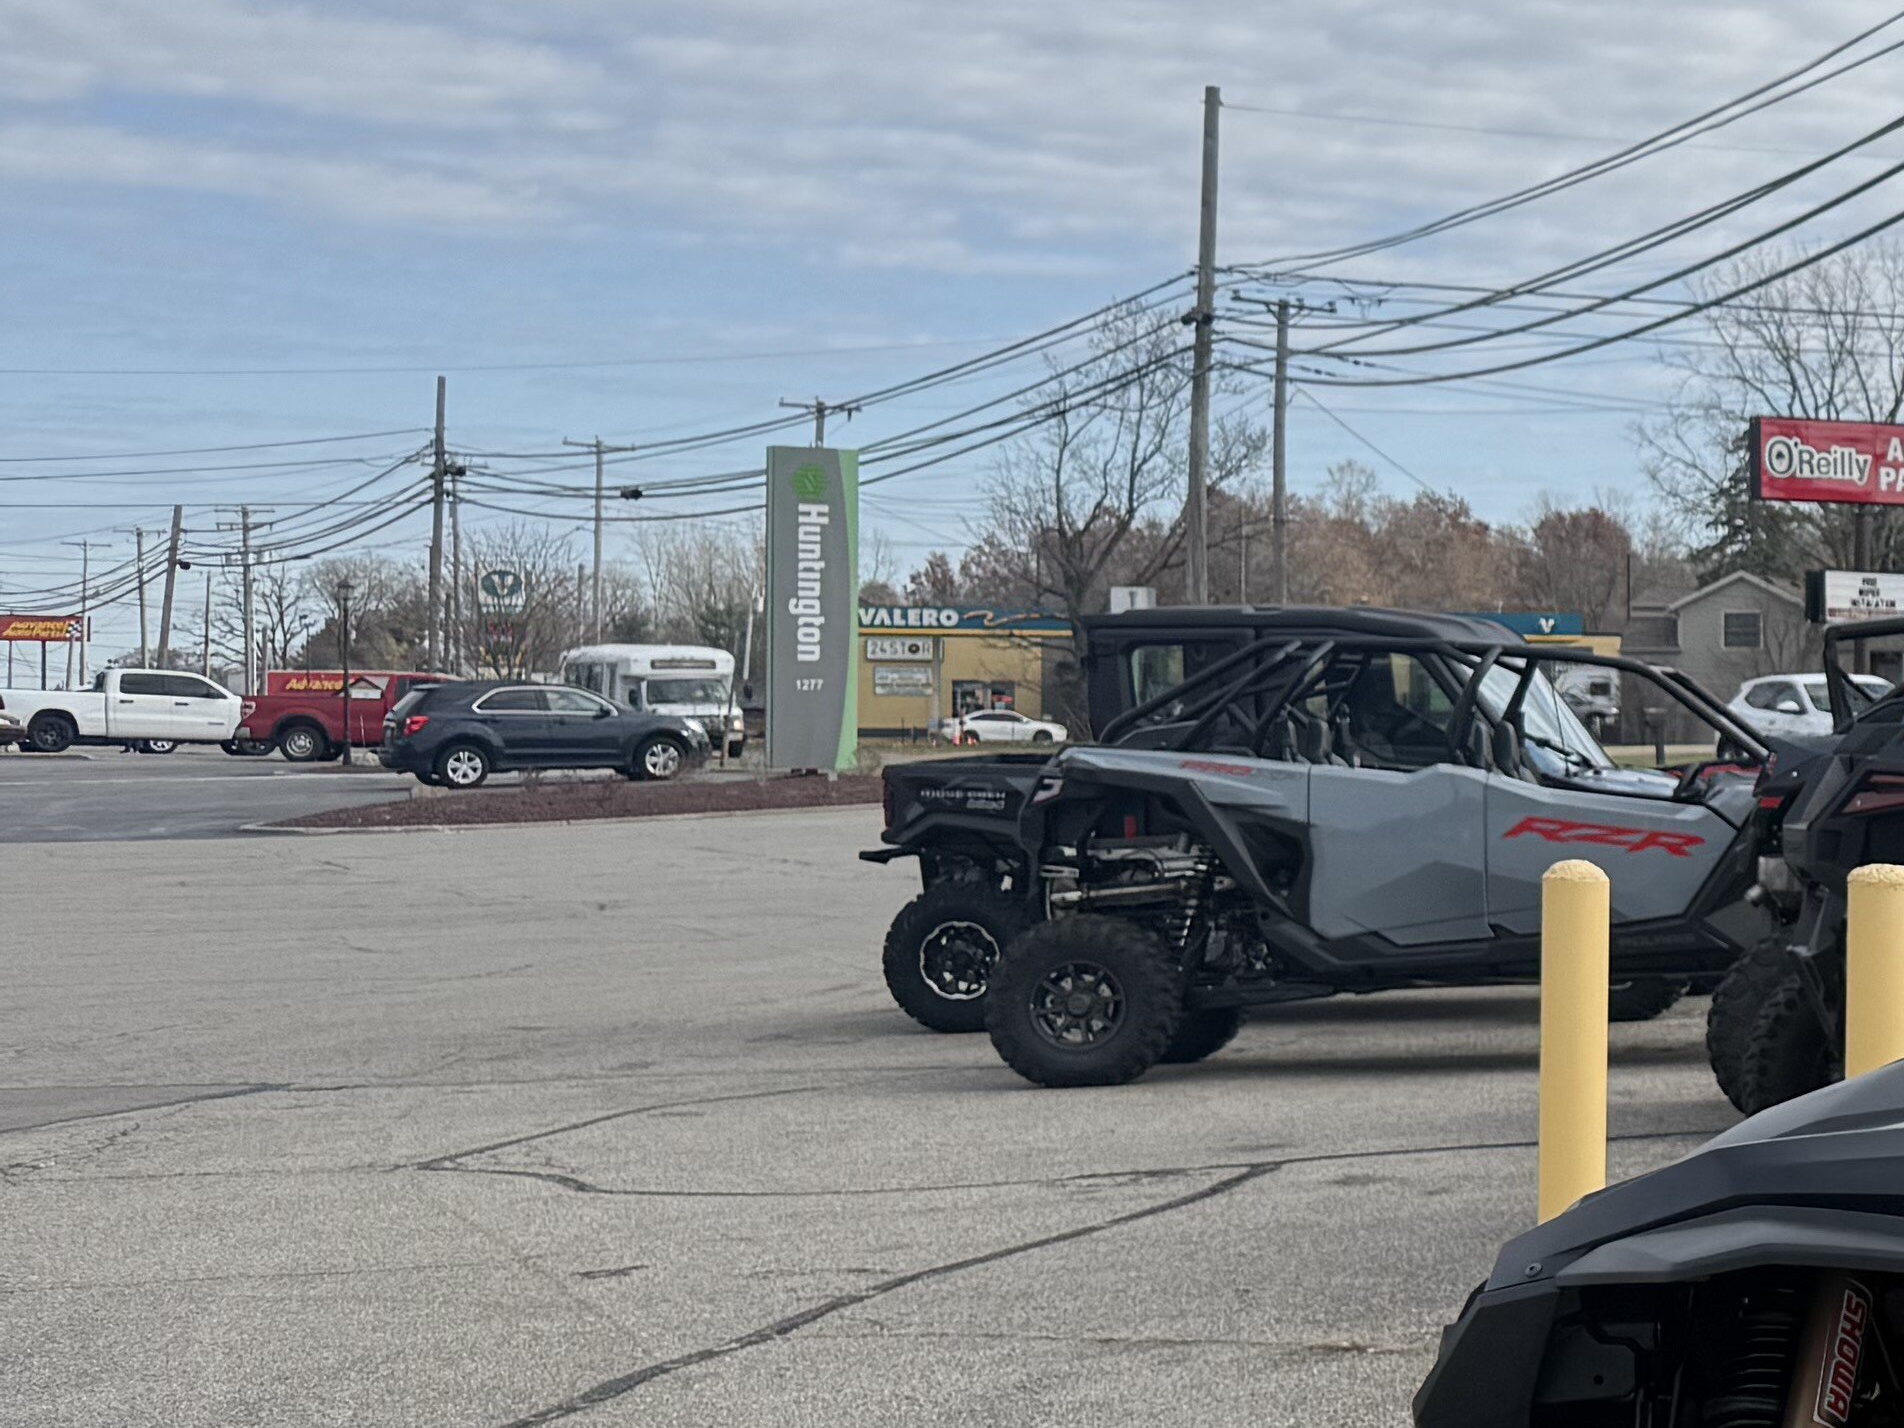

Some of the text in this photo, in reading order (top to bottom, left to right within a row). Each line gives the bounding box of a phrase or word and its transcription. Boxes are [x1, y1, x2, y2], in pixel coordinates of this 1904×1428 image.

[1766, 436, 1871, 483] O'Reilly
[788, 503, 829, 662] Huntington
[859, 608, 959, 627] VALERO
[796, 678, 823, 691] 1277
[1502, 816, 1706, 857] RZR
[1824, 1289, 1868, 1423] SHOWA
